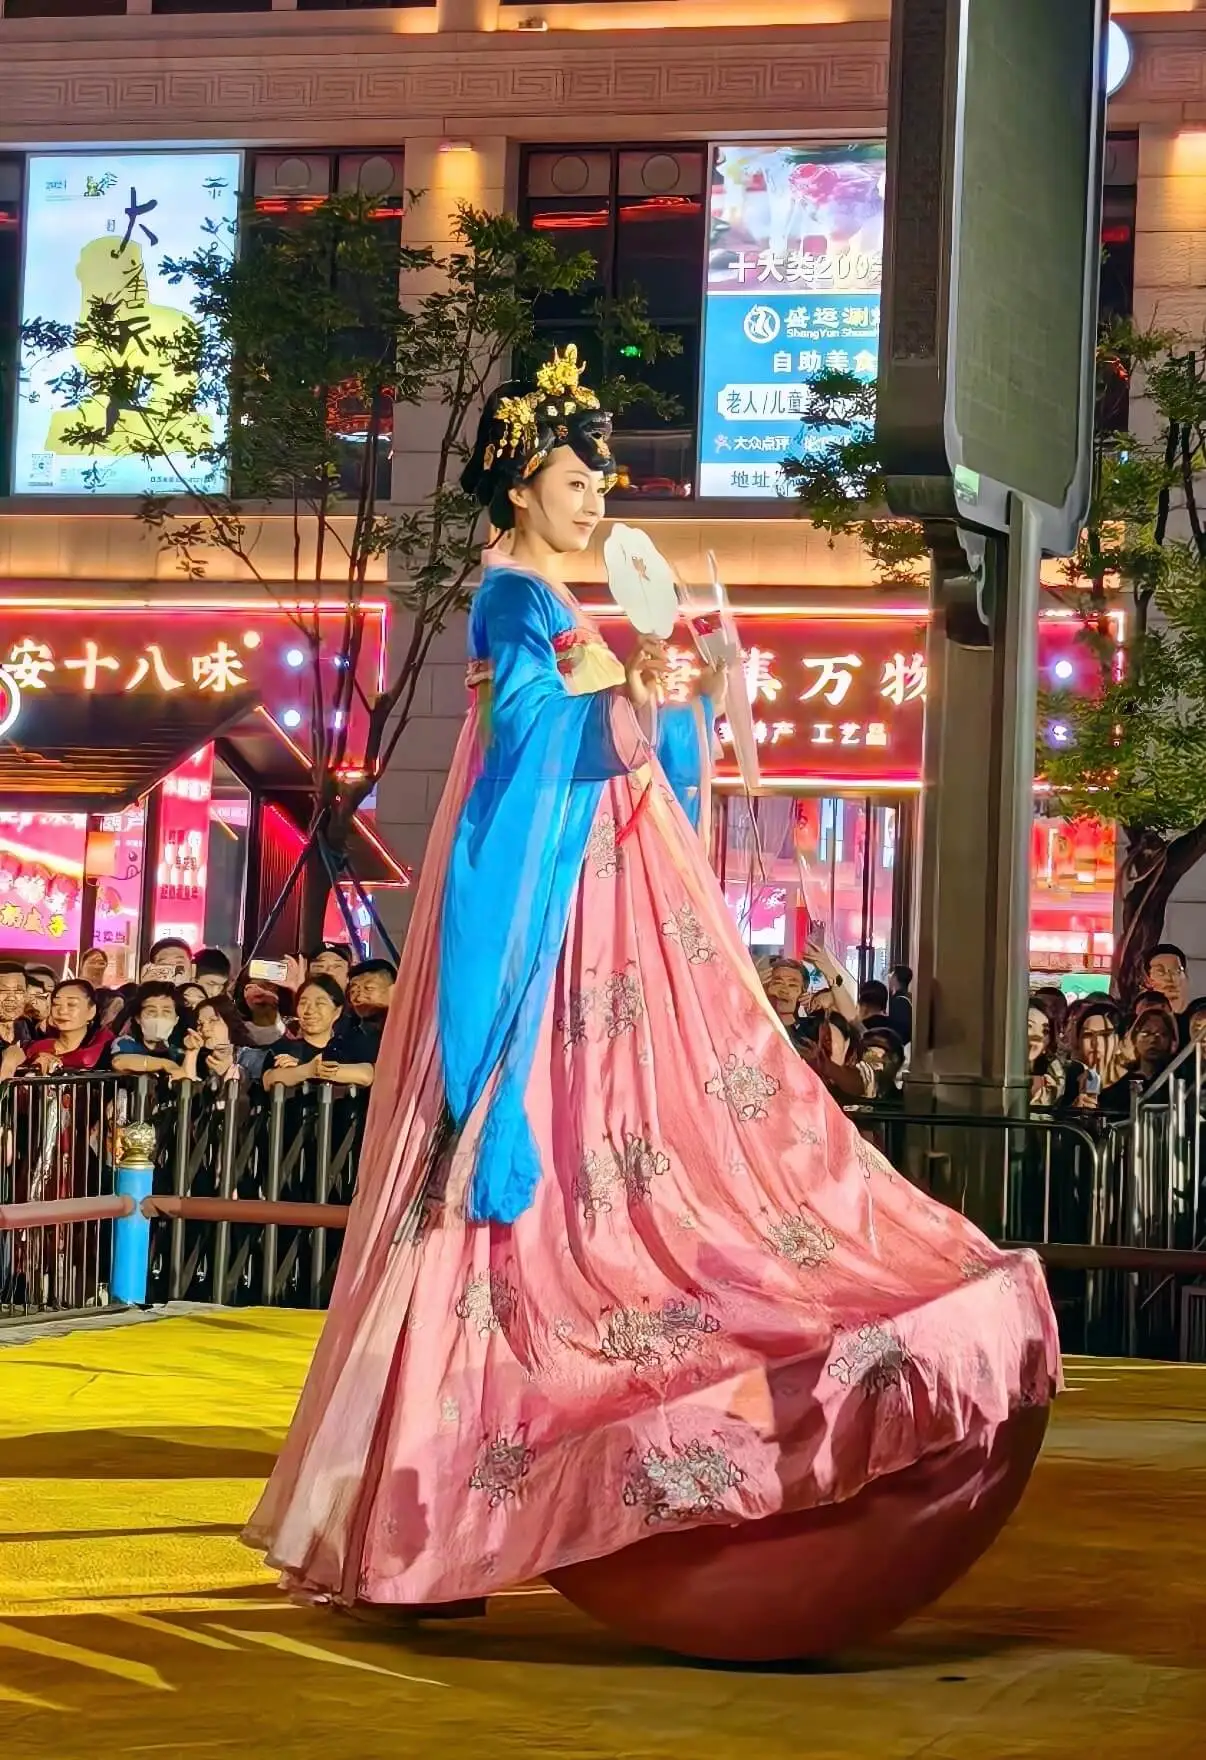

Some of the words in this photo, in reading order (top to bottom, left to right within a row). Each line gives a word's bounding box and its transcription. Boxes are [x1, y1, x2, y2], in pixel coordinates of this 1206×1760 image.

[1, 638, 249, 693] 安十八味
[811, 722, 887, 746] 工艺品
